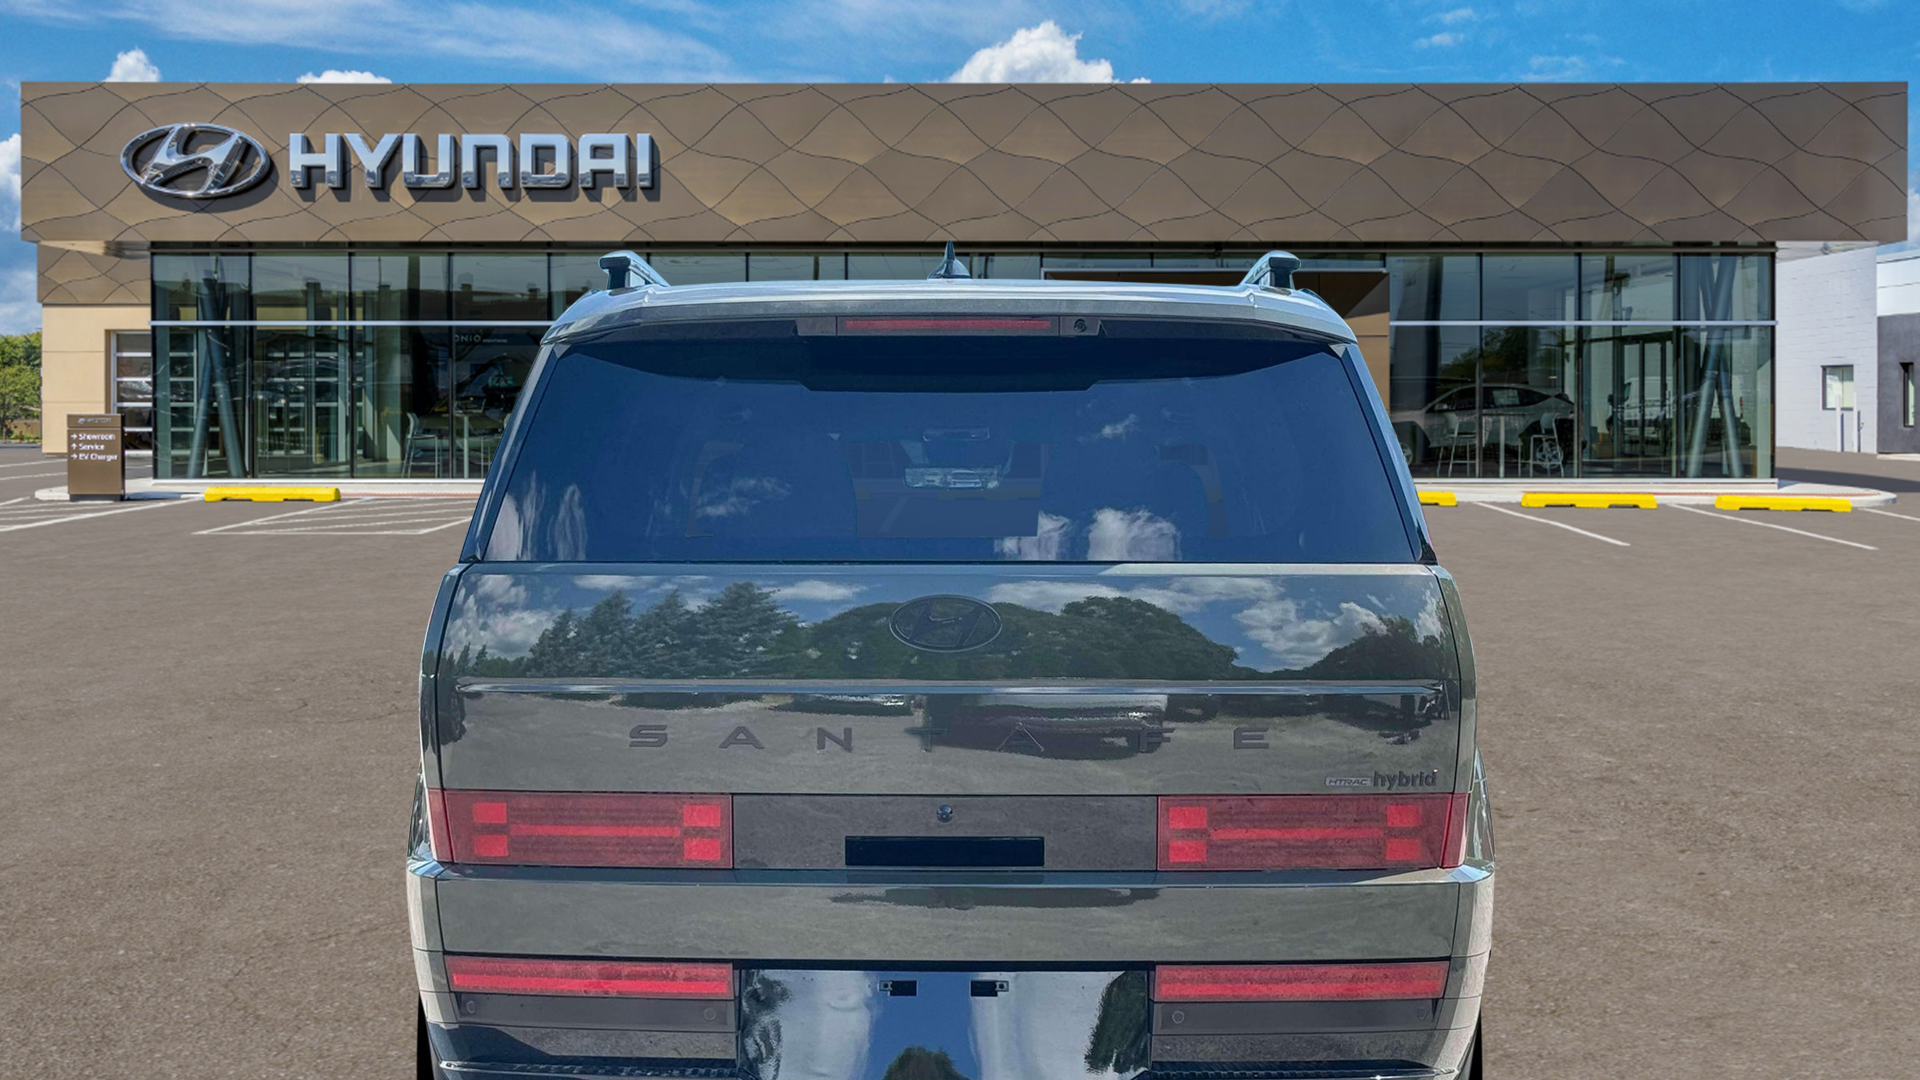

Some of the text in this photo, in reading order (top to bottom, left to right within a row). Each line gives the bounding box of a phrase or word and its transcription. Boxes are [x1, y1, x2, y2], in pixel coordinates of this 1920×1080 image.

[289, 132, 654, 189] HYUNDAI
[78, 442, 105, 450] Service
[90, 453, 118, 462] Charger
[629, 724, 1270, 752] SANTA FE
[1328, 770, 1437, 791] HTRAC hybrid
